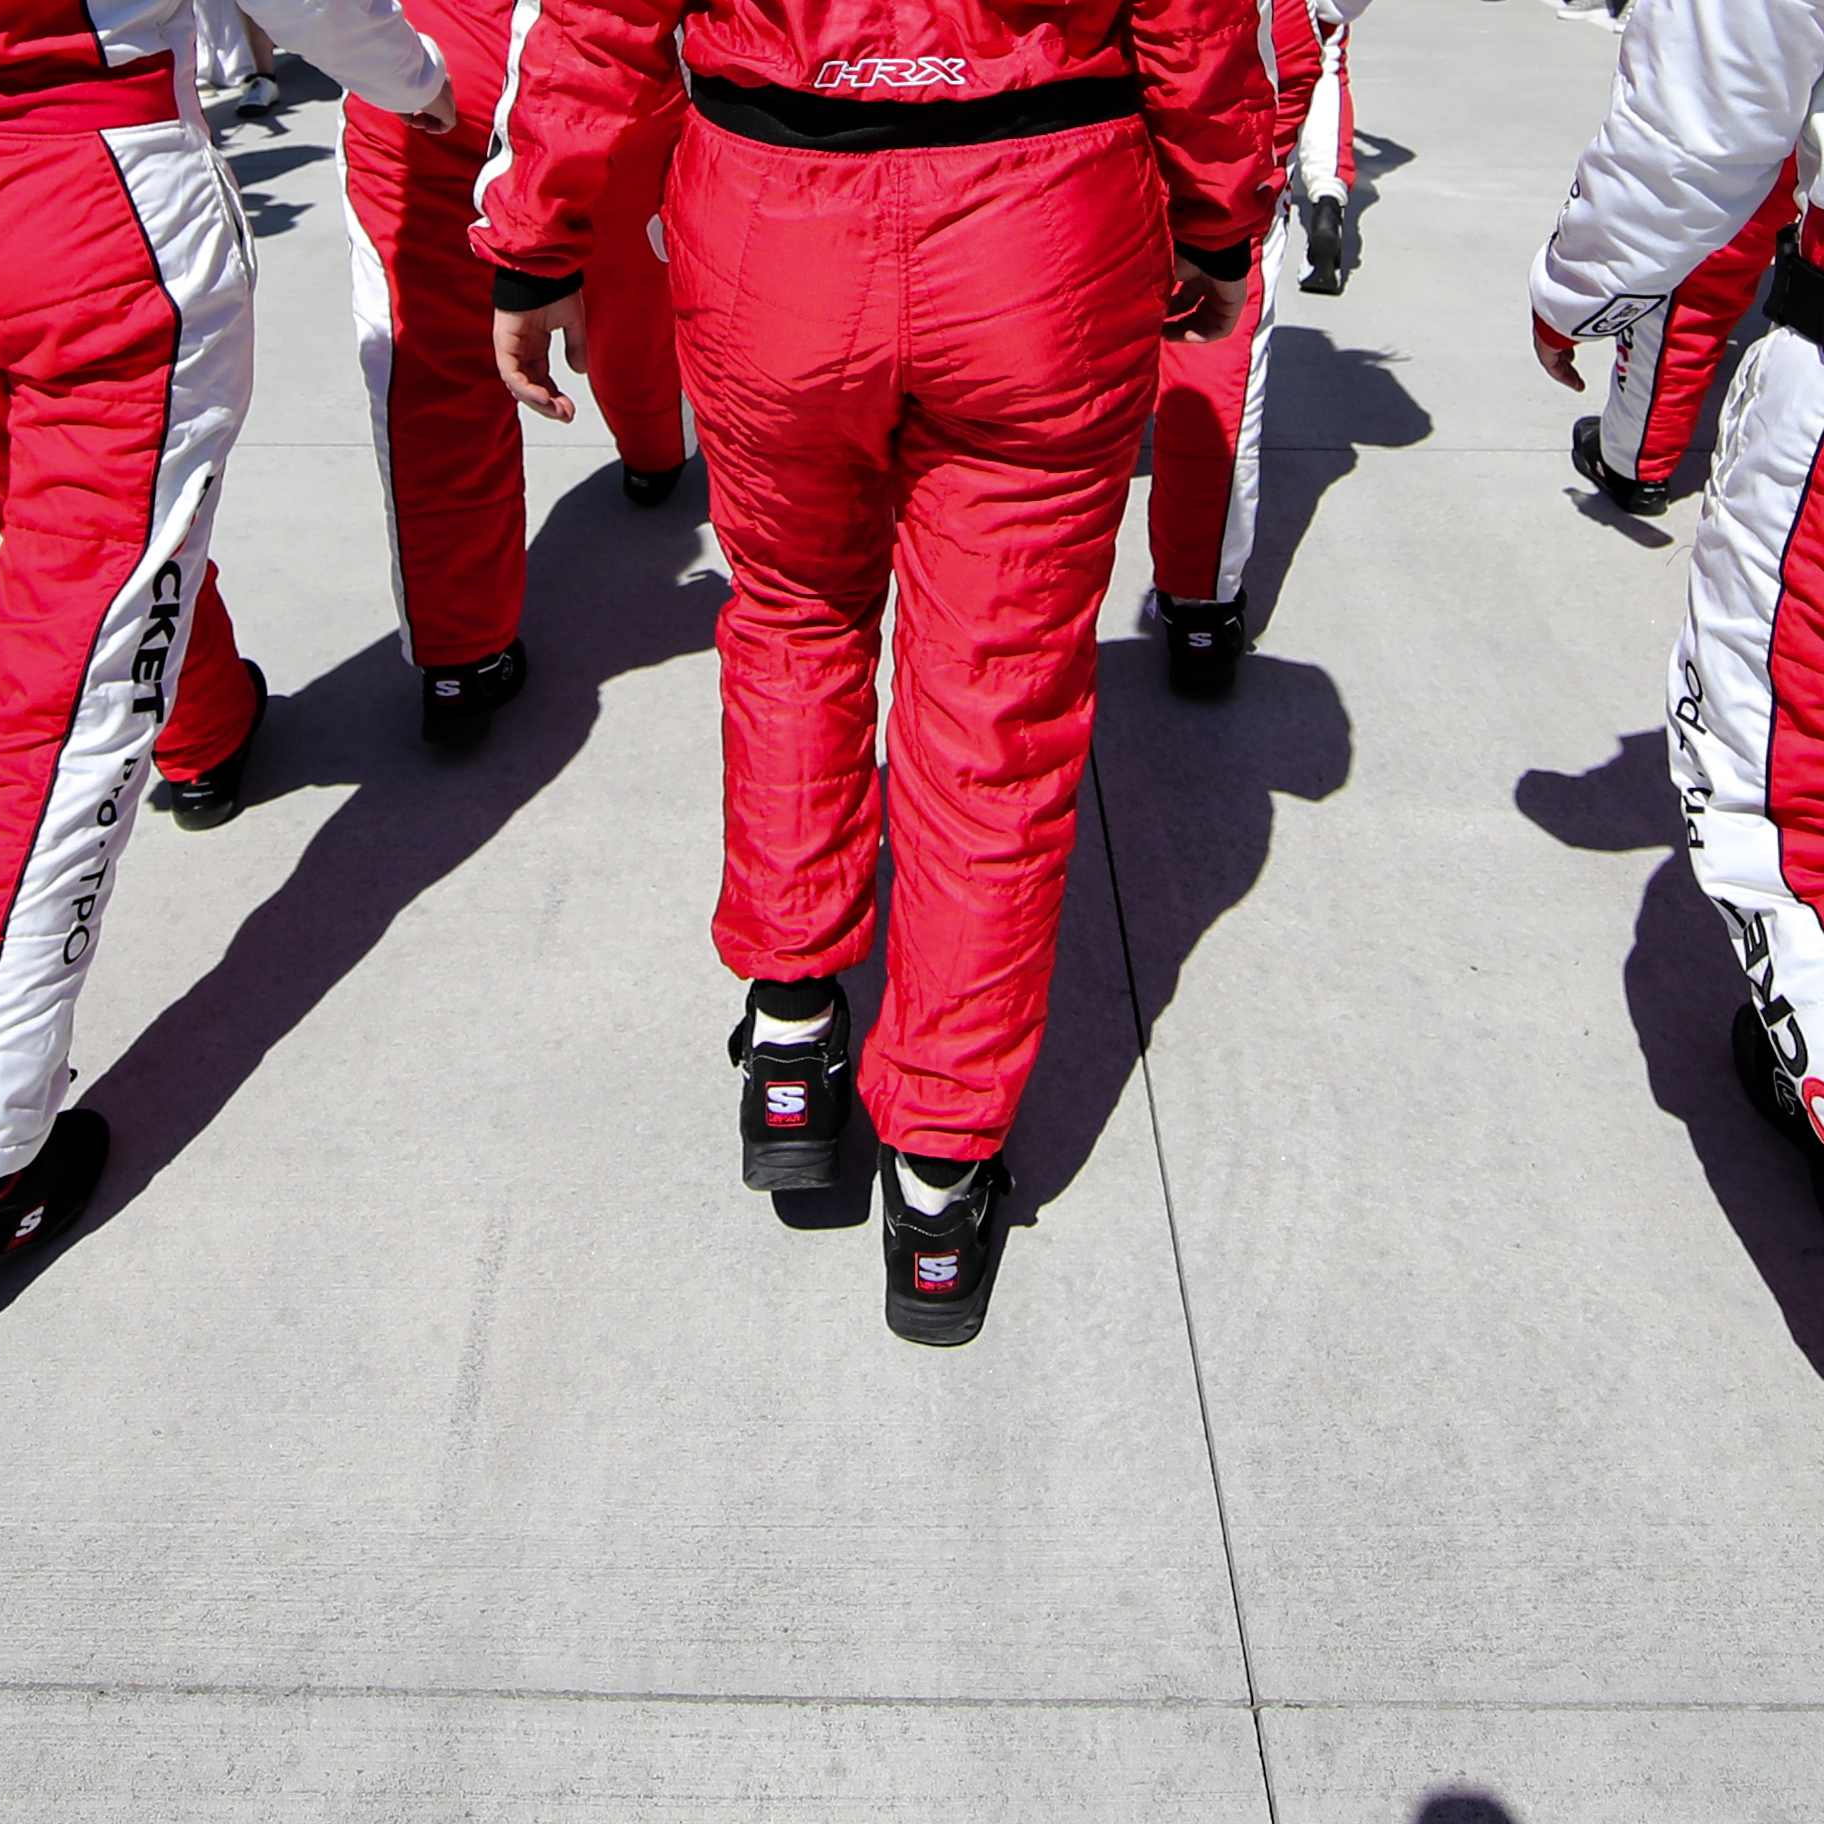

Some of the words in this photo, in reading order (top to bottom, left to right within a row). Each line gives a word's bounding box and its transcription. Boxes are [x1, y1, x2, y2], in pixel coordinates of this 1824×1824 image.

[814, 56, 965, 89] HRX
[435, 679, 461, 697] S
[63, 856, 112, 965] TPO
[767, 1086, 806, 1114] S
[14, 1206, 46, 1240] S
[919, 1255, 959, 1283] S
